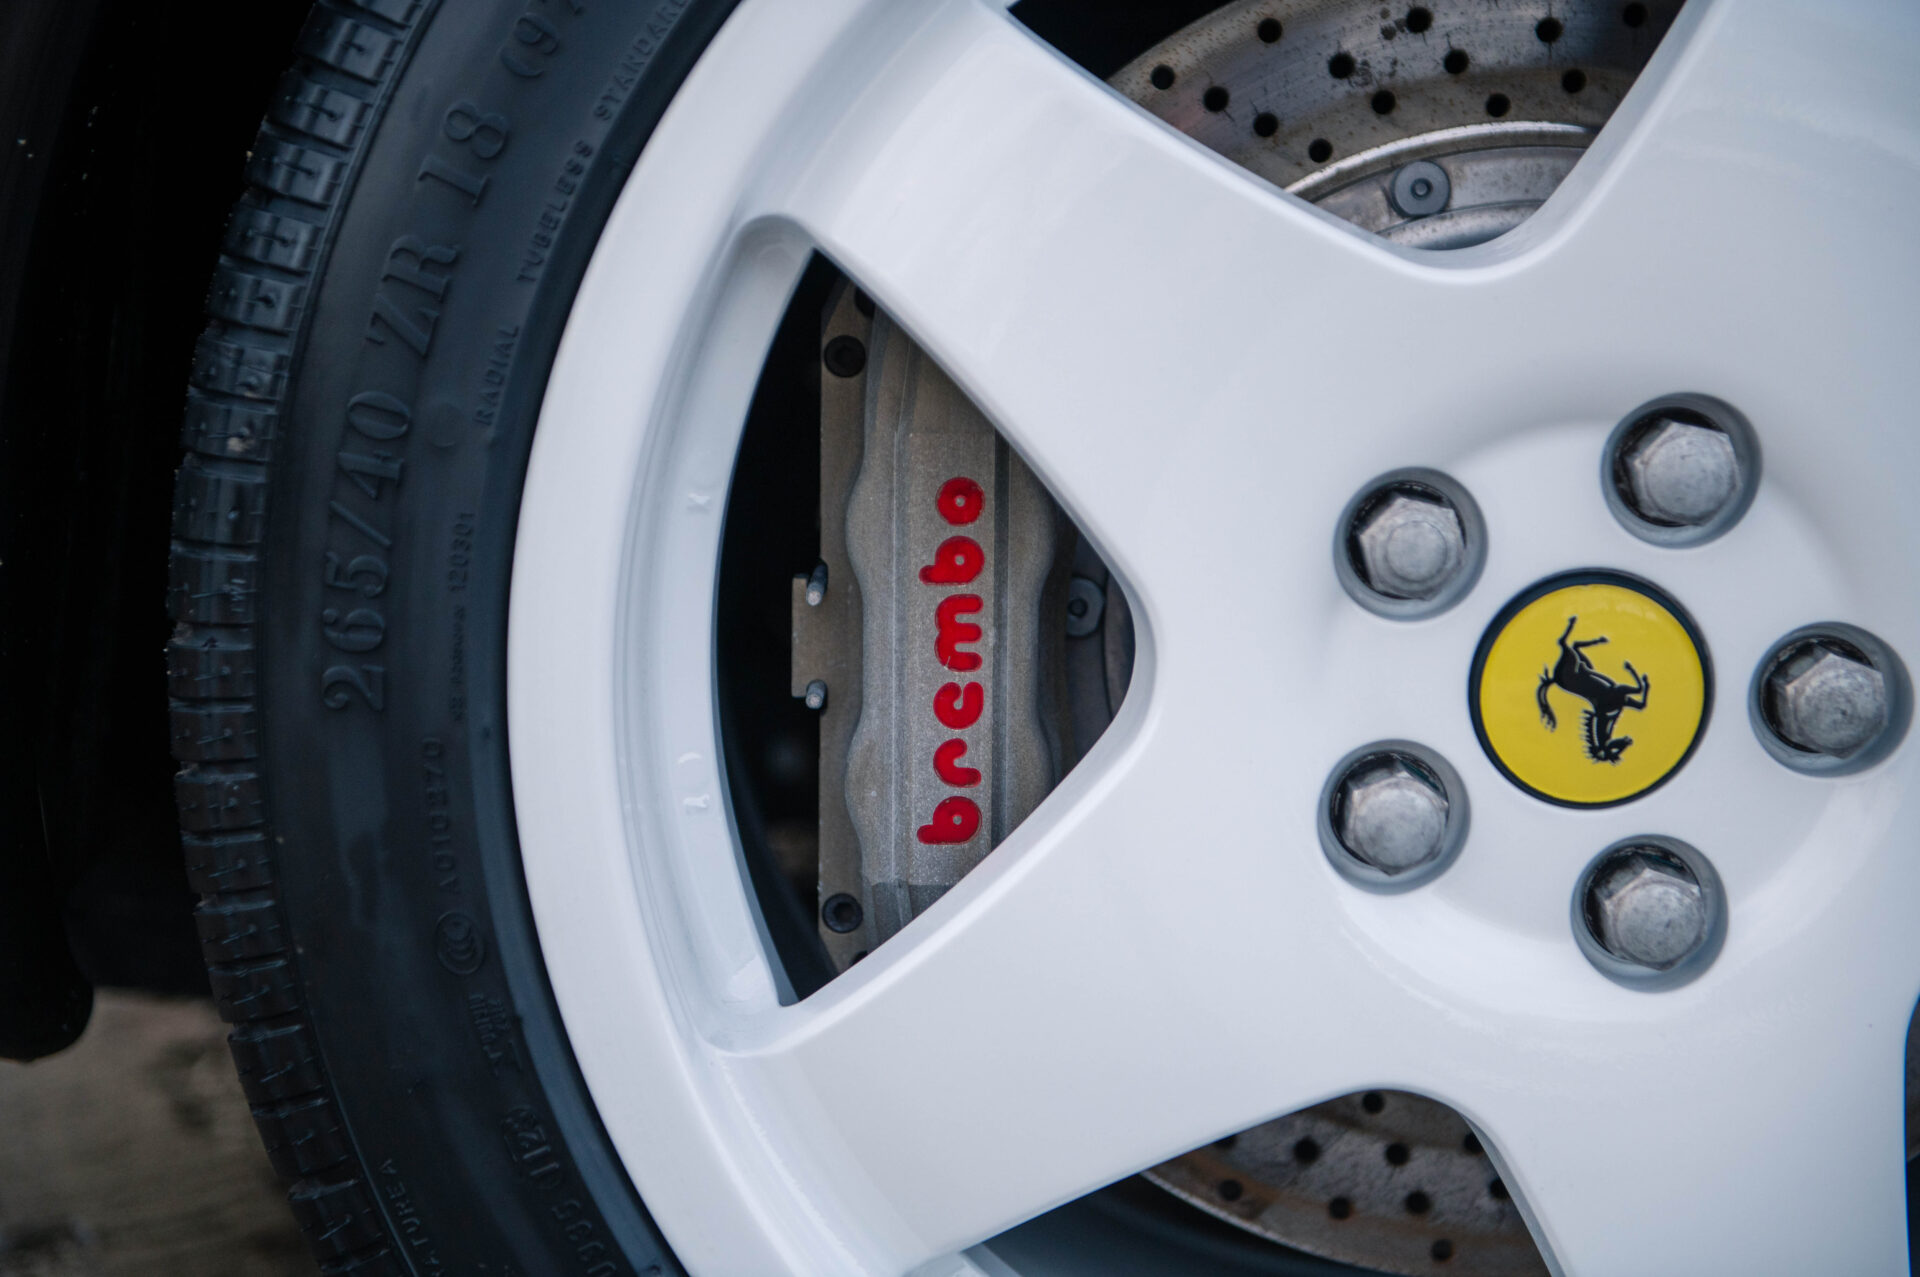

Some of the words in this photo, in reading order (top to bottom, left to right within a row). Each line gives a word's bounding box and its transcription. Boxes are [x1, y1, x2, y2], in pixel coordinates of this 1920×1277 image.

[321, 390, 411, 711] 265/40
[366, 234, 460, 358] ZR
[416, 103, 508, 206] 18
[474, 325, 520, 427] RADIAL
[516, 139, 594, 284] TUBELESS
[917, 477, 986, 845] brembo
[388, 1183, 445, 1277] ATURE
